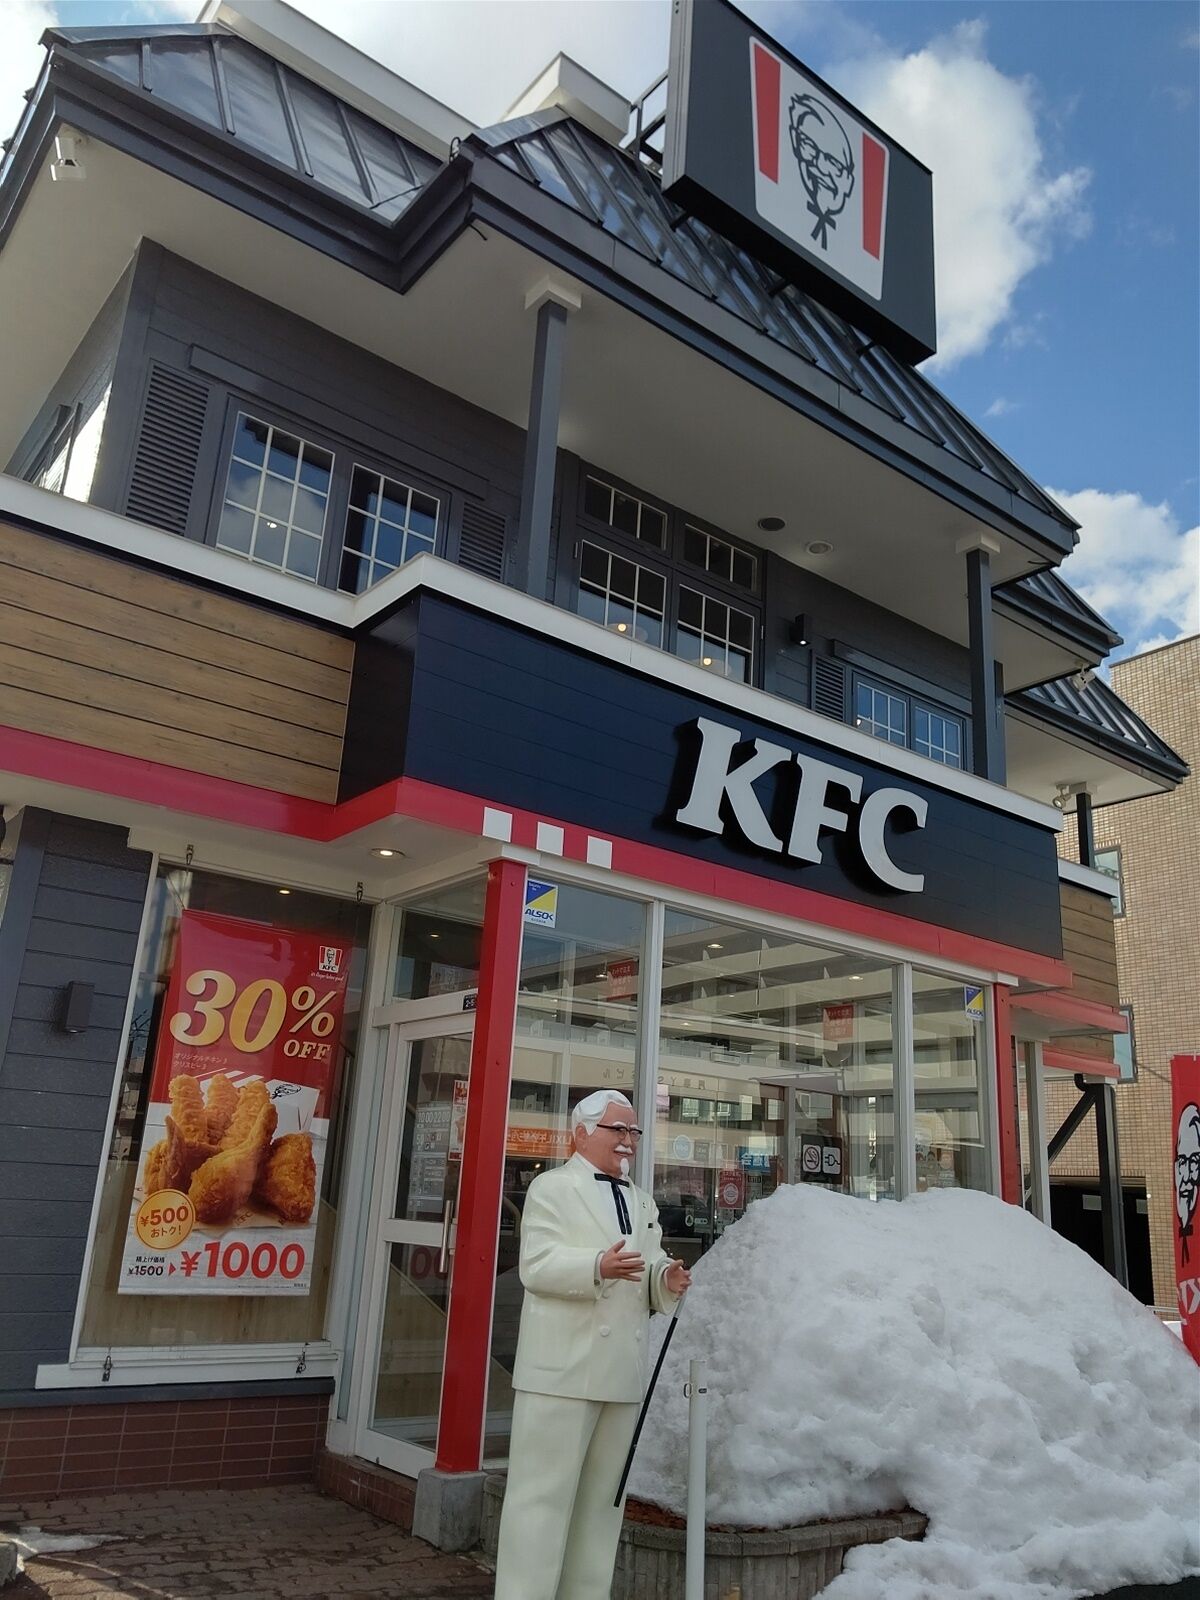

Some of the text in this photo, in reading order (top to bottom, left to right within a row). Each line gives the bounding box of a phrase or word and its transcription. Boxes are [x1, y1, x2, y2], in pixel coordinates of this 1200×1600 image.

[676, 716, 928, 893] KFC
[524, 908, 554, 921] ALSOK
[283, 1038, 331, 1061] OFF
[139, 1206, 189, 1227] ¥500
[128, 1265, 164, 1276] ¥1500
[180, 1241, 306, 1279] ¥1000
